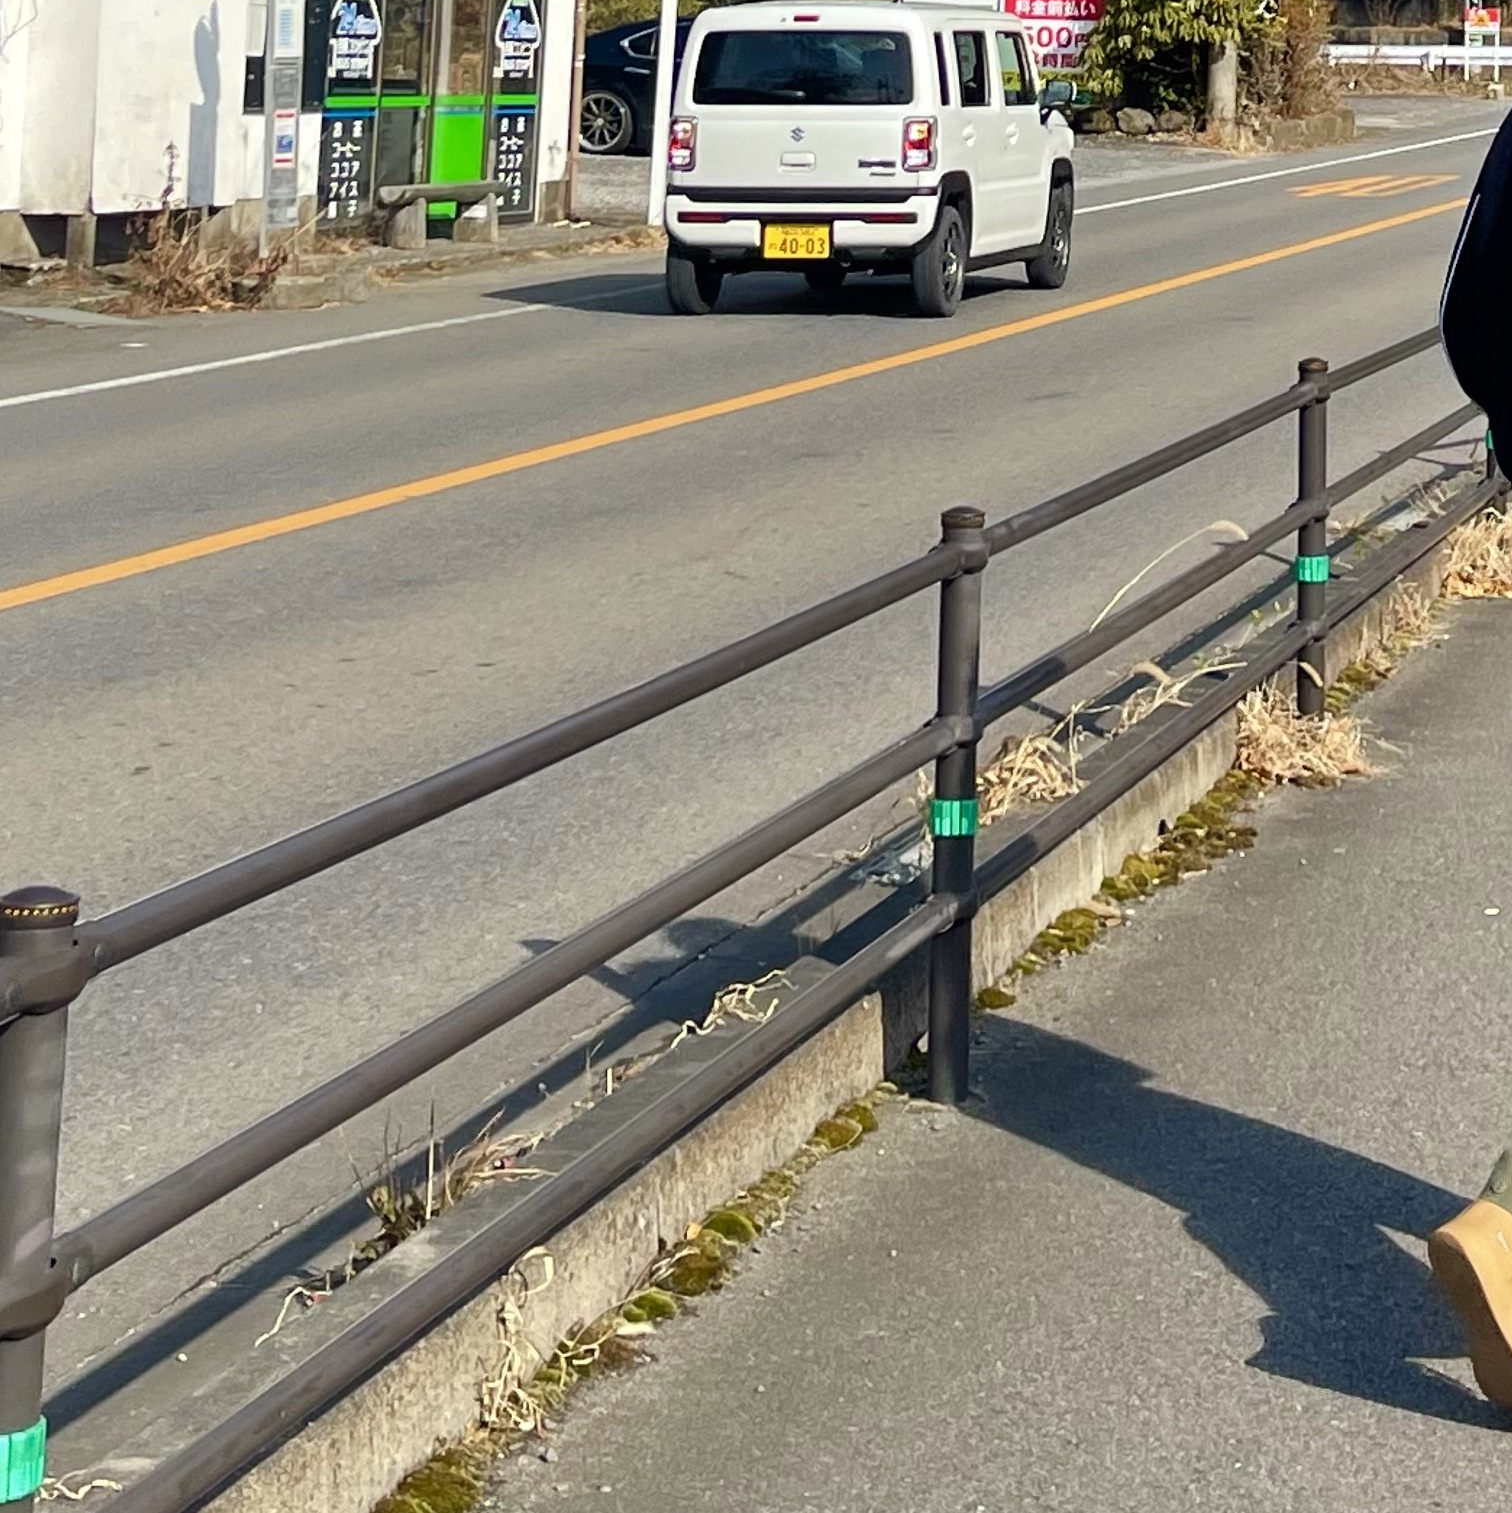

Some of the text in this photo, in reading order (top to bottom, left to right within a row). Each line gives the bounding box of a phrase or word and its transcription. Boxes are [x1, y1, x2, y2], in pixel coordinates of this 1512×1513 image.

[1014, 0, 1098, 18] 料金前払い
[778, 237, 826, 255] 40-03
